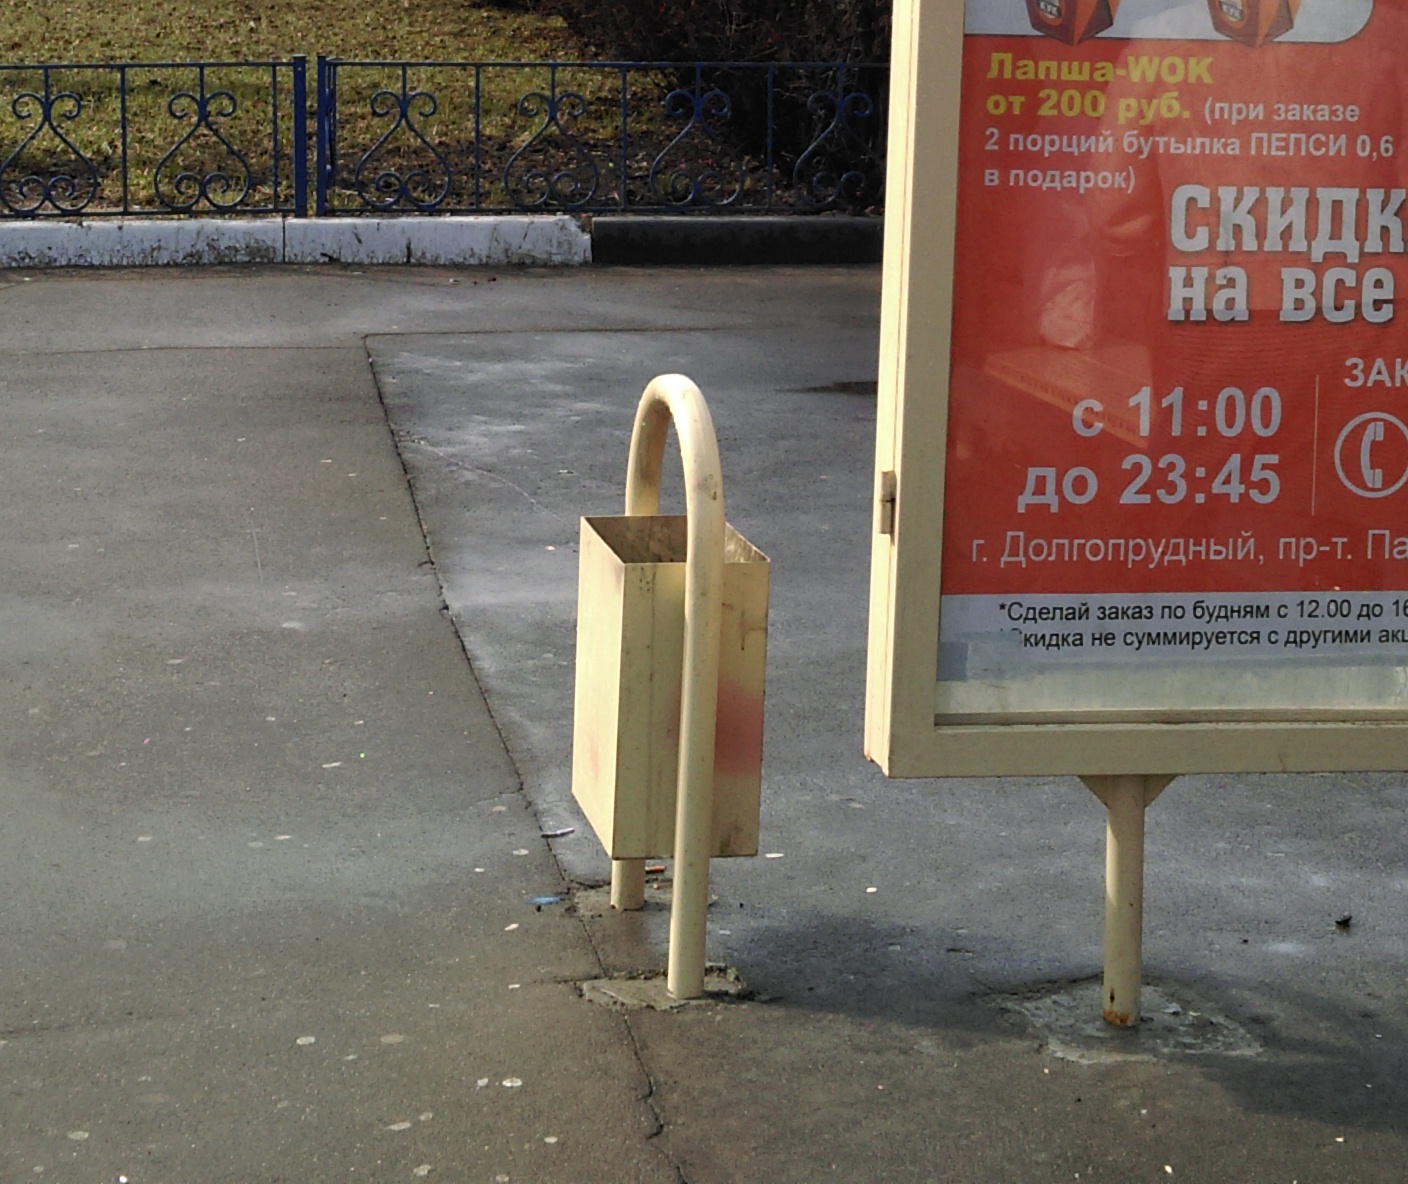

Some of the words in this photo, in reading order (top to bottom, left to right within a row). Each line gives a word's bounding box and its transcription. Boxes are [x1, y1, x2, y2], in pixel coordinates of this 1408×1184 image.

[987, 53, 1213, 84] Лапша-WOK
[986, 94, 1025, 115] от
[1038, 89, 1104, 117] 200
[1118, 92, 1190, 124] руб.
[1204, 97, 1265, 124] (при
[1273, 101, 1360, 122] заказе
[985, 128, 999, 151] 2
[1009, 130, 1113, 157] порций
[1123, 129, 1241, 158] бутылка
[1250, 133, 1347, 157] ПЕПСИ
[1356, 135, 1394, 161] 0,6
[984, 168, 999, 186] в
[1009, 166, 1136, 192] подарок)
[1167, 266, 1250, 323] на
[1279, 266, 1395, 323] все
[1072, 398, 1105, 437] с
[1128, 386, 1282, 437] 11:00
[1017, 466, 1098, 513] до
[1119, 453, 1281, 505] 23:45
[971, 538, 988, 562] г.
[1000, 530, 1265, 568] Долгопрудный,
[1278, 535, 1352, 567] пр-т.
[1097, 605, 1154, 620] заказ
[1160, 604, 1186, 620] по
[1192, 600, 1270, 623] будням
[1277, 604, 1288, 618] с
[1296, 599, 1352, 618] 12.00
[1357, 603, 1383, 621] до
[1091, 631, 1116, 646] не
[1123, 629, 1260, 649] суммируется
[1267, 631, 1278, 645] с
[1284, 629, 1372, 649] другими
